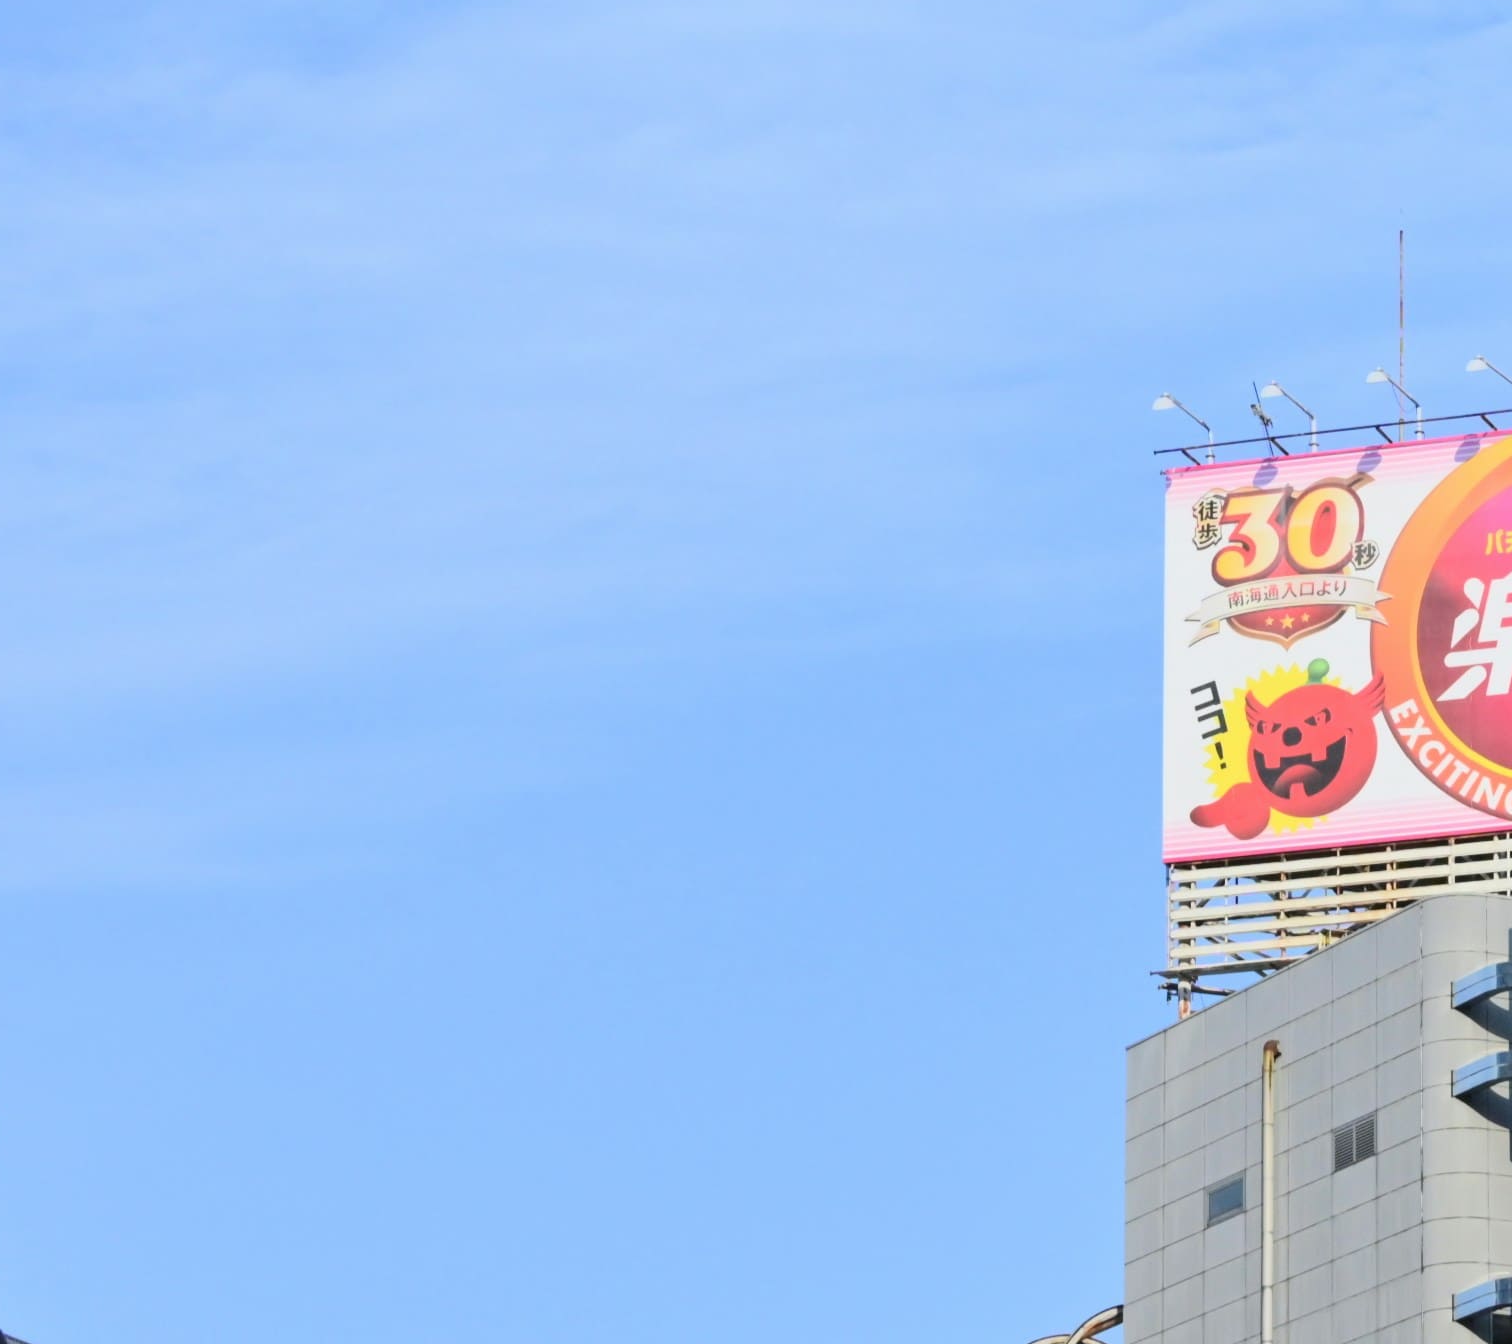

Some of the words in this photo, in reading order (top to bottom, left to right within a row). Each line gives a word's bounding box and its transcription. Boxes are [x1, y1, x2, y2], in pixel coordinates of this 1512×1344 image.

[1196, 498, 1220, 546] 徒歩
[1212, 485, 1363, 582] 30
[1354, 540, 1377, 568] 秒
[1227, 577, 1348, 610] 南海通入口より
